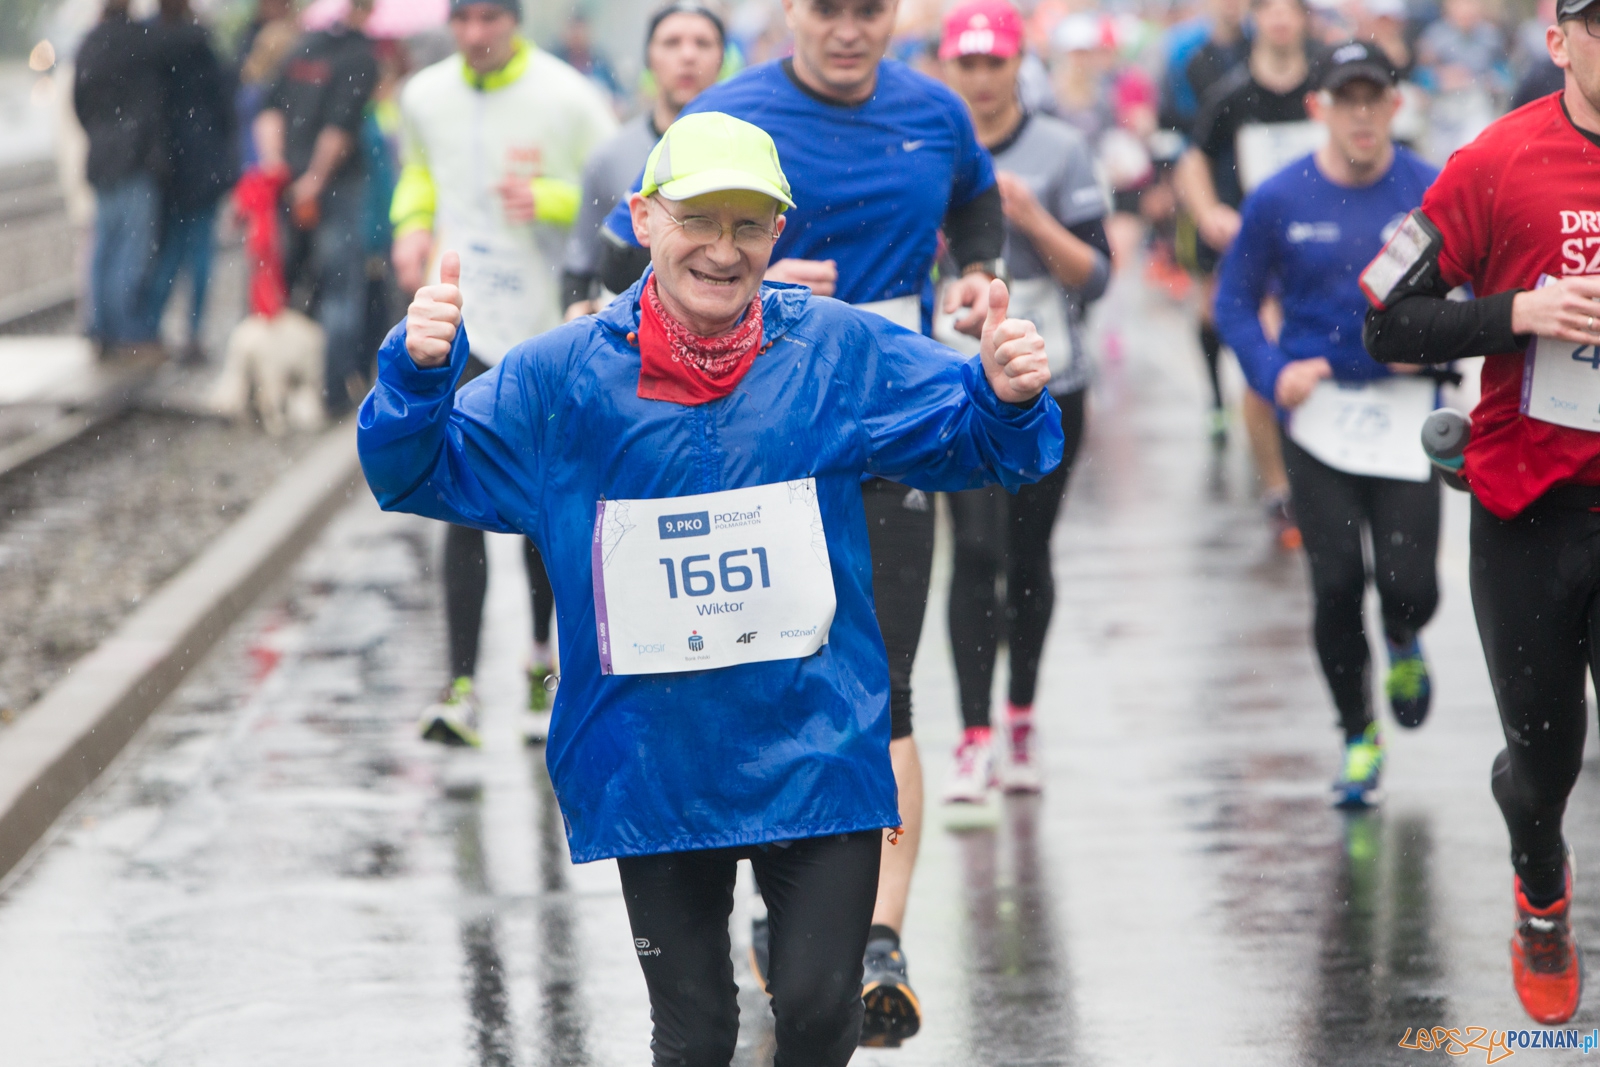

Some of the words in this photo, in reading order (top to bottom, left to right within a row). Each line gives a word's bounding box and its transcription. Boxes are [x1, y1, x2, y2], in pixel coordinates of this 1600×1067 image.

[1559, 210, 1600, 234] DR
[659, 546, 771, 599] 1661
[696, 601, 745, 616] Wiktor
[736, 631, 758, 644] 4F
